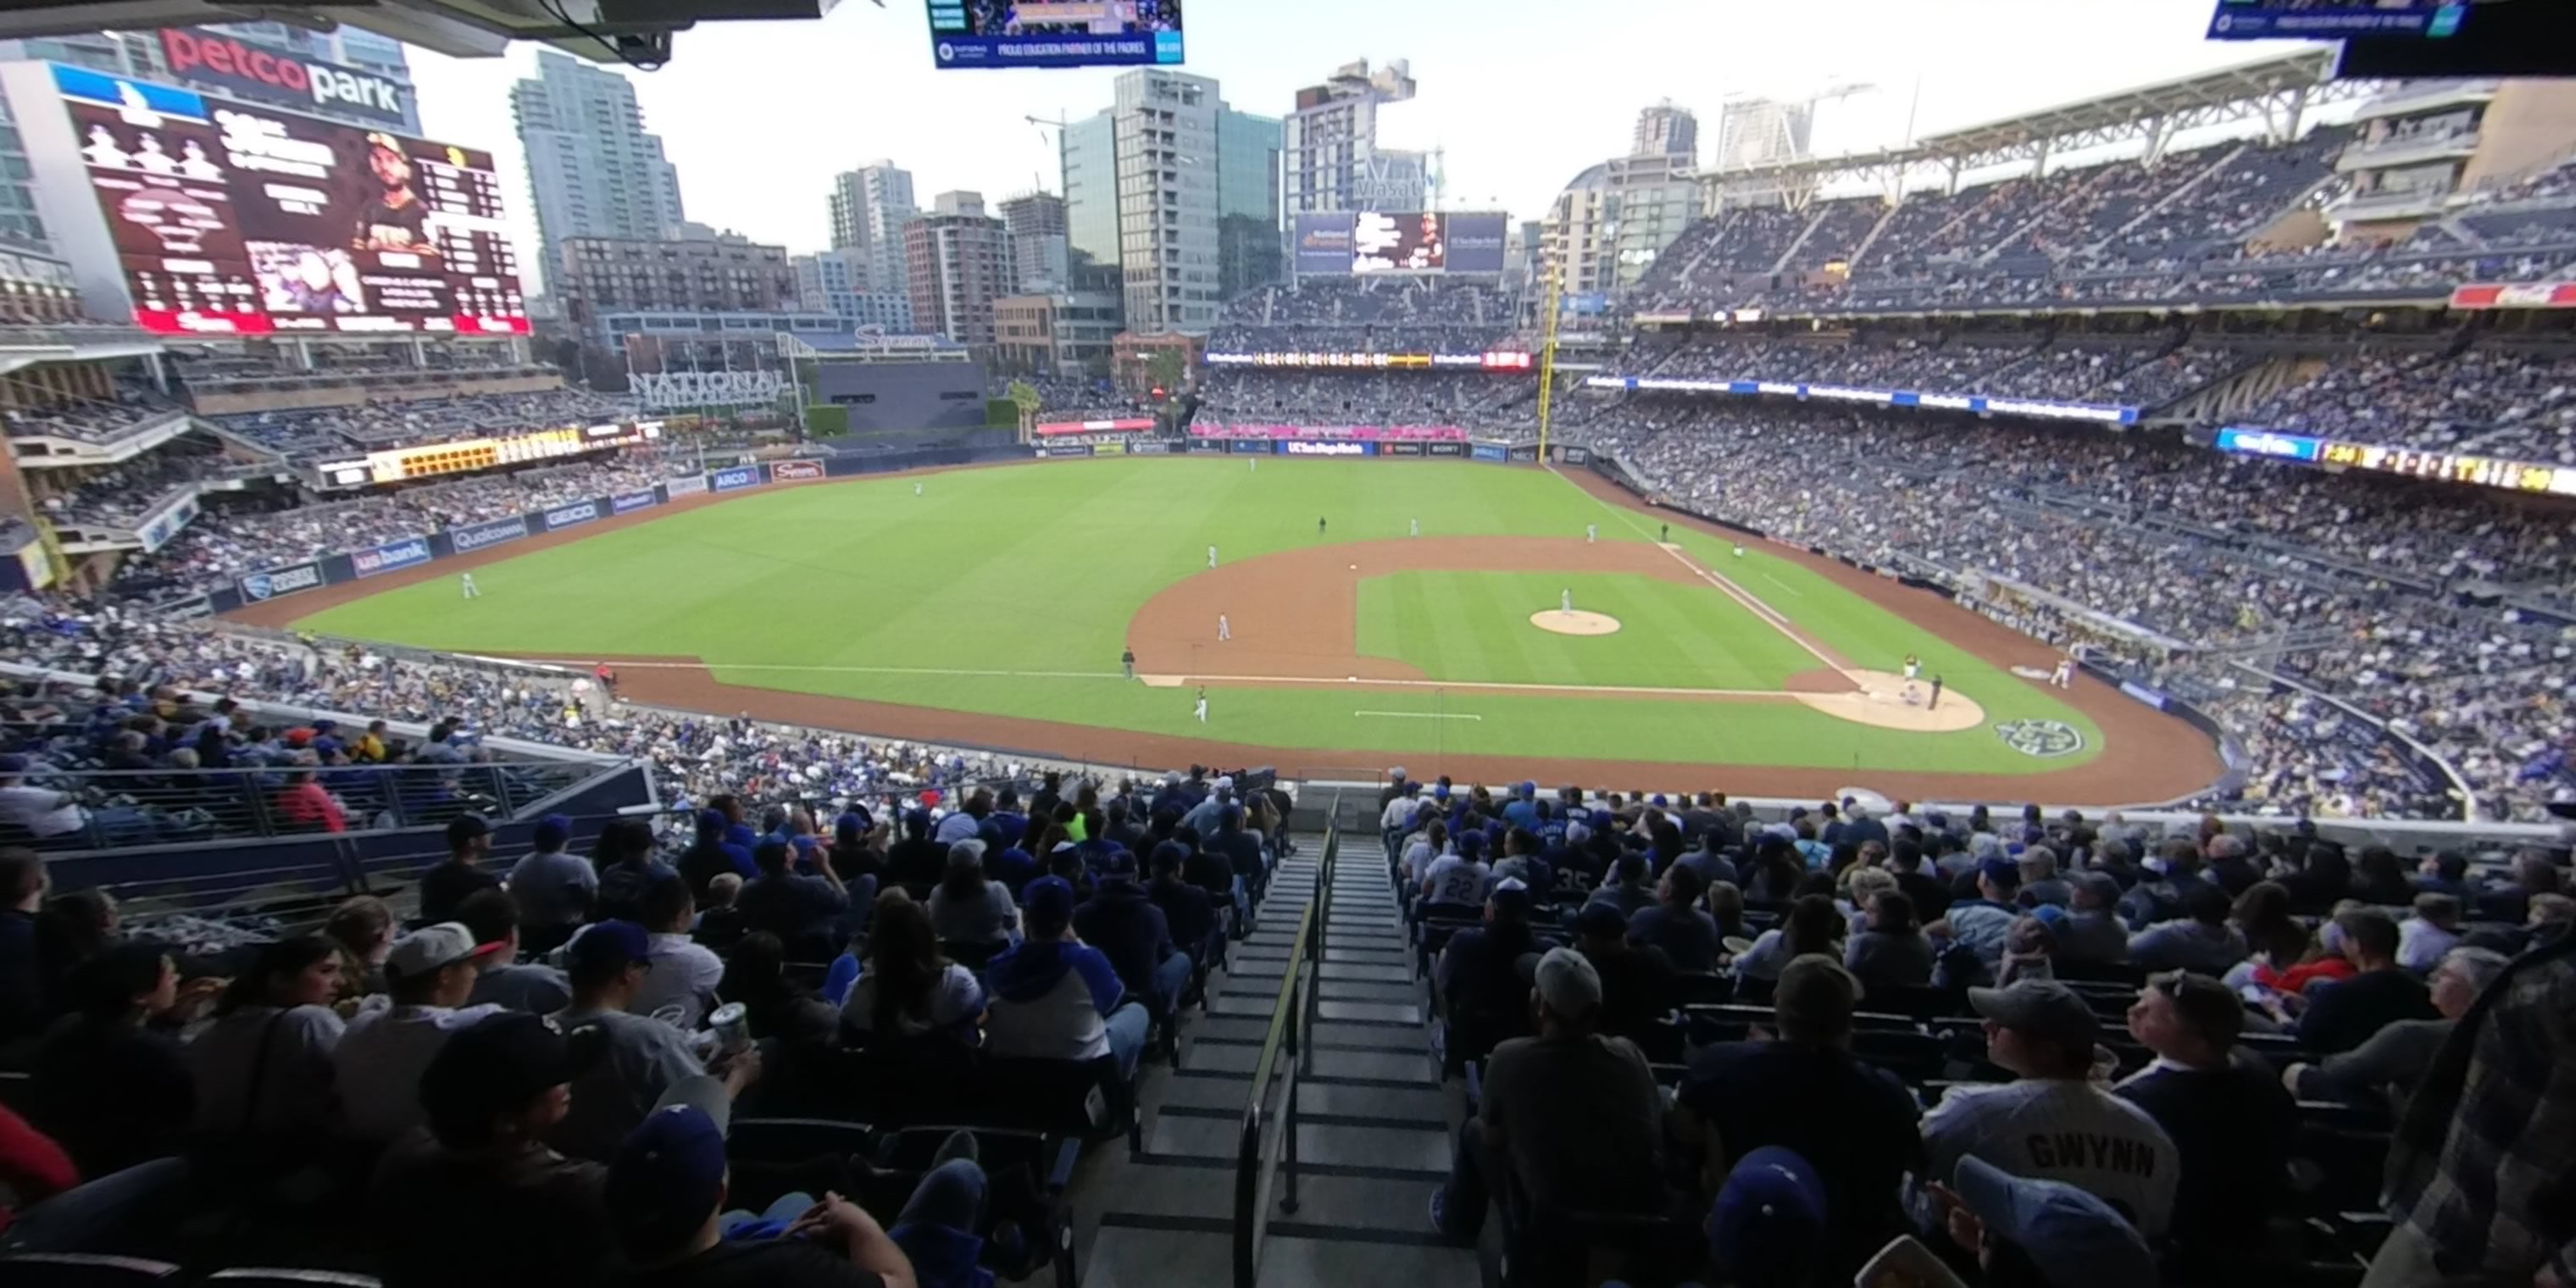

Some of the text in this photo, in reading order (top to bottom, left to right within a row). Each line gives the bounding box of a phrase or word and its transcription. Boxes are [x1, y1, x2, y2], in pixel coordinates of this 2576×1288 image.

[1092, 42, 1102, 54] OF
[161, 28, 400, 112] petco park
[1357, 179, 1416, 197] Viasat
[626, 369, 791, 395] NATIONAL
[1288, 441, 1302, 454] UC
[1302, 442, 1316, 454] San
[717, 472, 747, 488] ARCO
[548, 504, 595, 526] GEICO
[455, 524, 523, 548] Qualcomm
[1445, 876, 1473, 899] 22
[1555, 867, 1591, 894] 35
[2026, 1131, 2155, 1179] GWYNN
